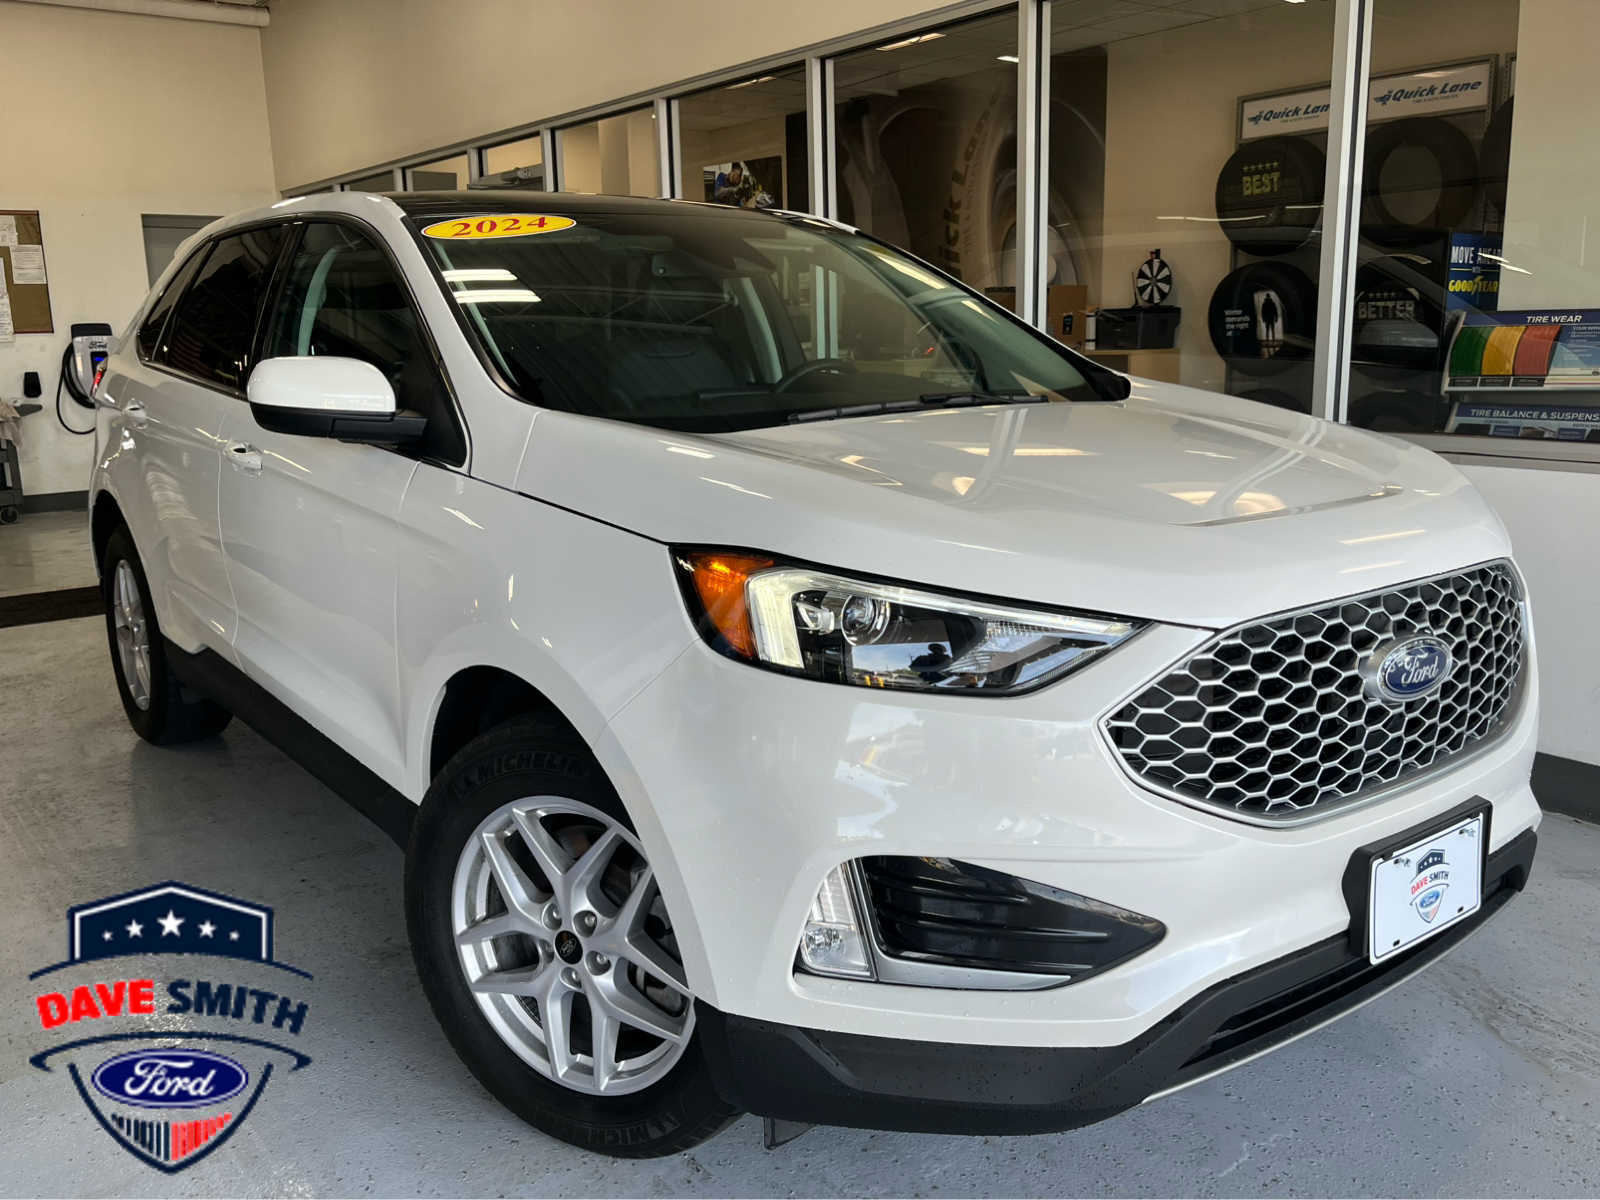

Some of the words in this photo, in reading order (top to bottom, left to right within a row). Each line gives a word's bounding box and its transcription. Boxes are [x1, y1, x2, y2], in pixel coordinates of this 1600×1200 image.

[1391, 88, 1437, 102] Quick
[1439, 80, 1483, 94] Lane
[1263, 106, 1302, 121] Quick
[1303, 103, 1330, 115] Lan
[1241, 170, 1282, 197] BEST
[451, 216, 549, 237] 2024
[1450, 246, 1475, 265] MOVE
[1448, 276, 1500, 295] GOODYEAR
[1358, 299, 1415, 321] BETTER
[1526, 315, 1549, 324] TIRE
[1551, 315, 1582, 323] WEAR
[1470, 408, 1491, 418] TIRE
[1492, 409, 1539, 420] BALANCE
[1540, 411, 1548, 420] &
[1401, 653, 1439, 685] Ford
[1410, 876, 1430, 895] DAVE
[1429, 870, 1449, 884] SMITH
